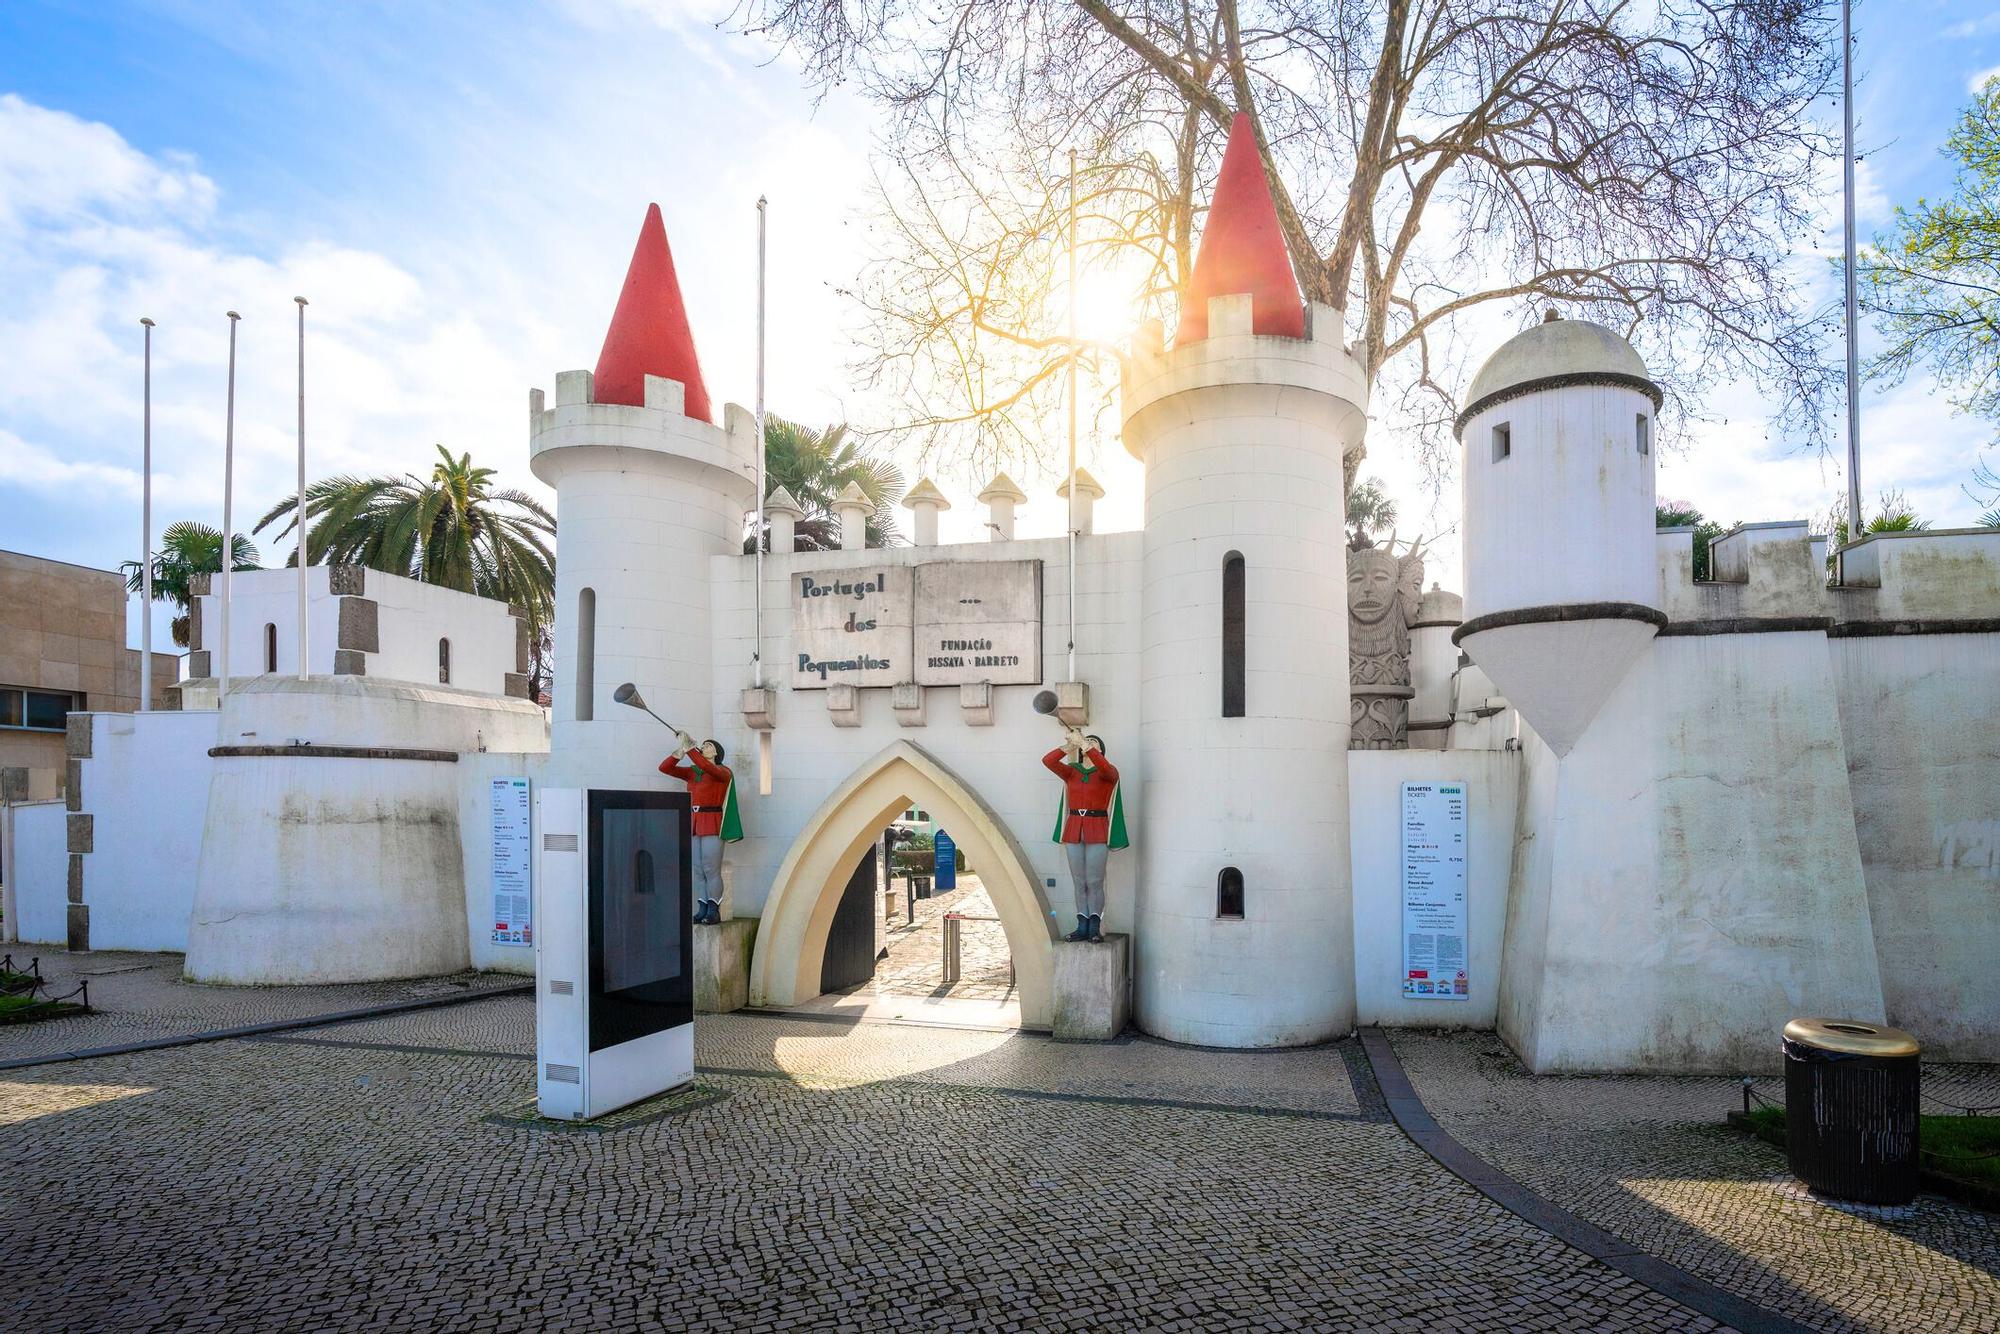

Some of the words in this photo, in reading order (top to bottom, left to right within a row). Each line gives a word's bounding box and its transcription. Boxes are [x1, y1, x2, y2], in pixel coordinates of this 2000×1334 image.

[801, 573, 884, 600] Portugal
[844, 612, 877, 632] dos
[798, 653, 890, 680] Pequenitos
[928, 656, 964, 668] BISSAYA
[975, 656, 1019, 667] BARRETO
